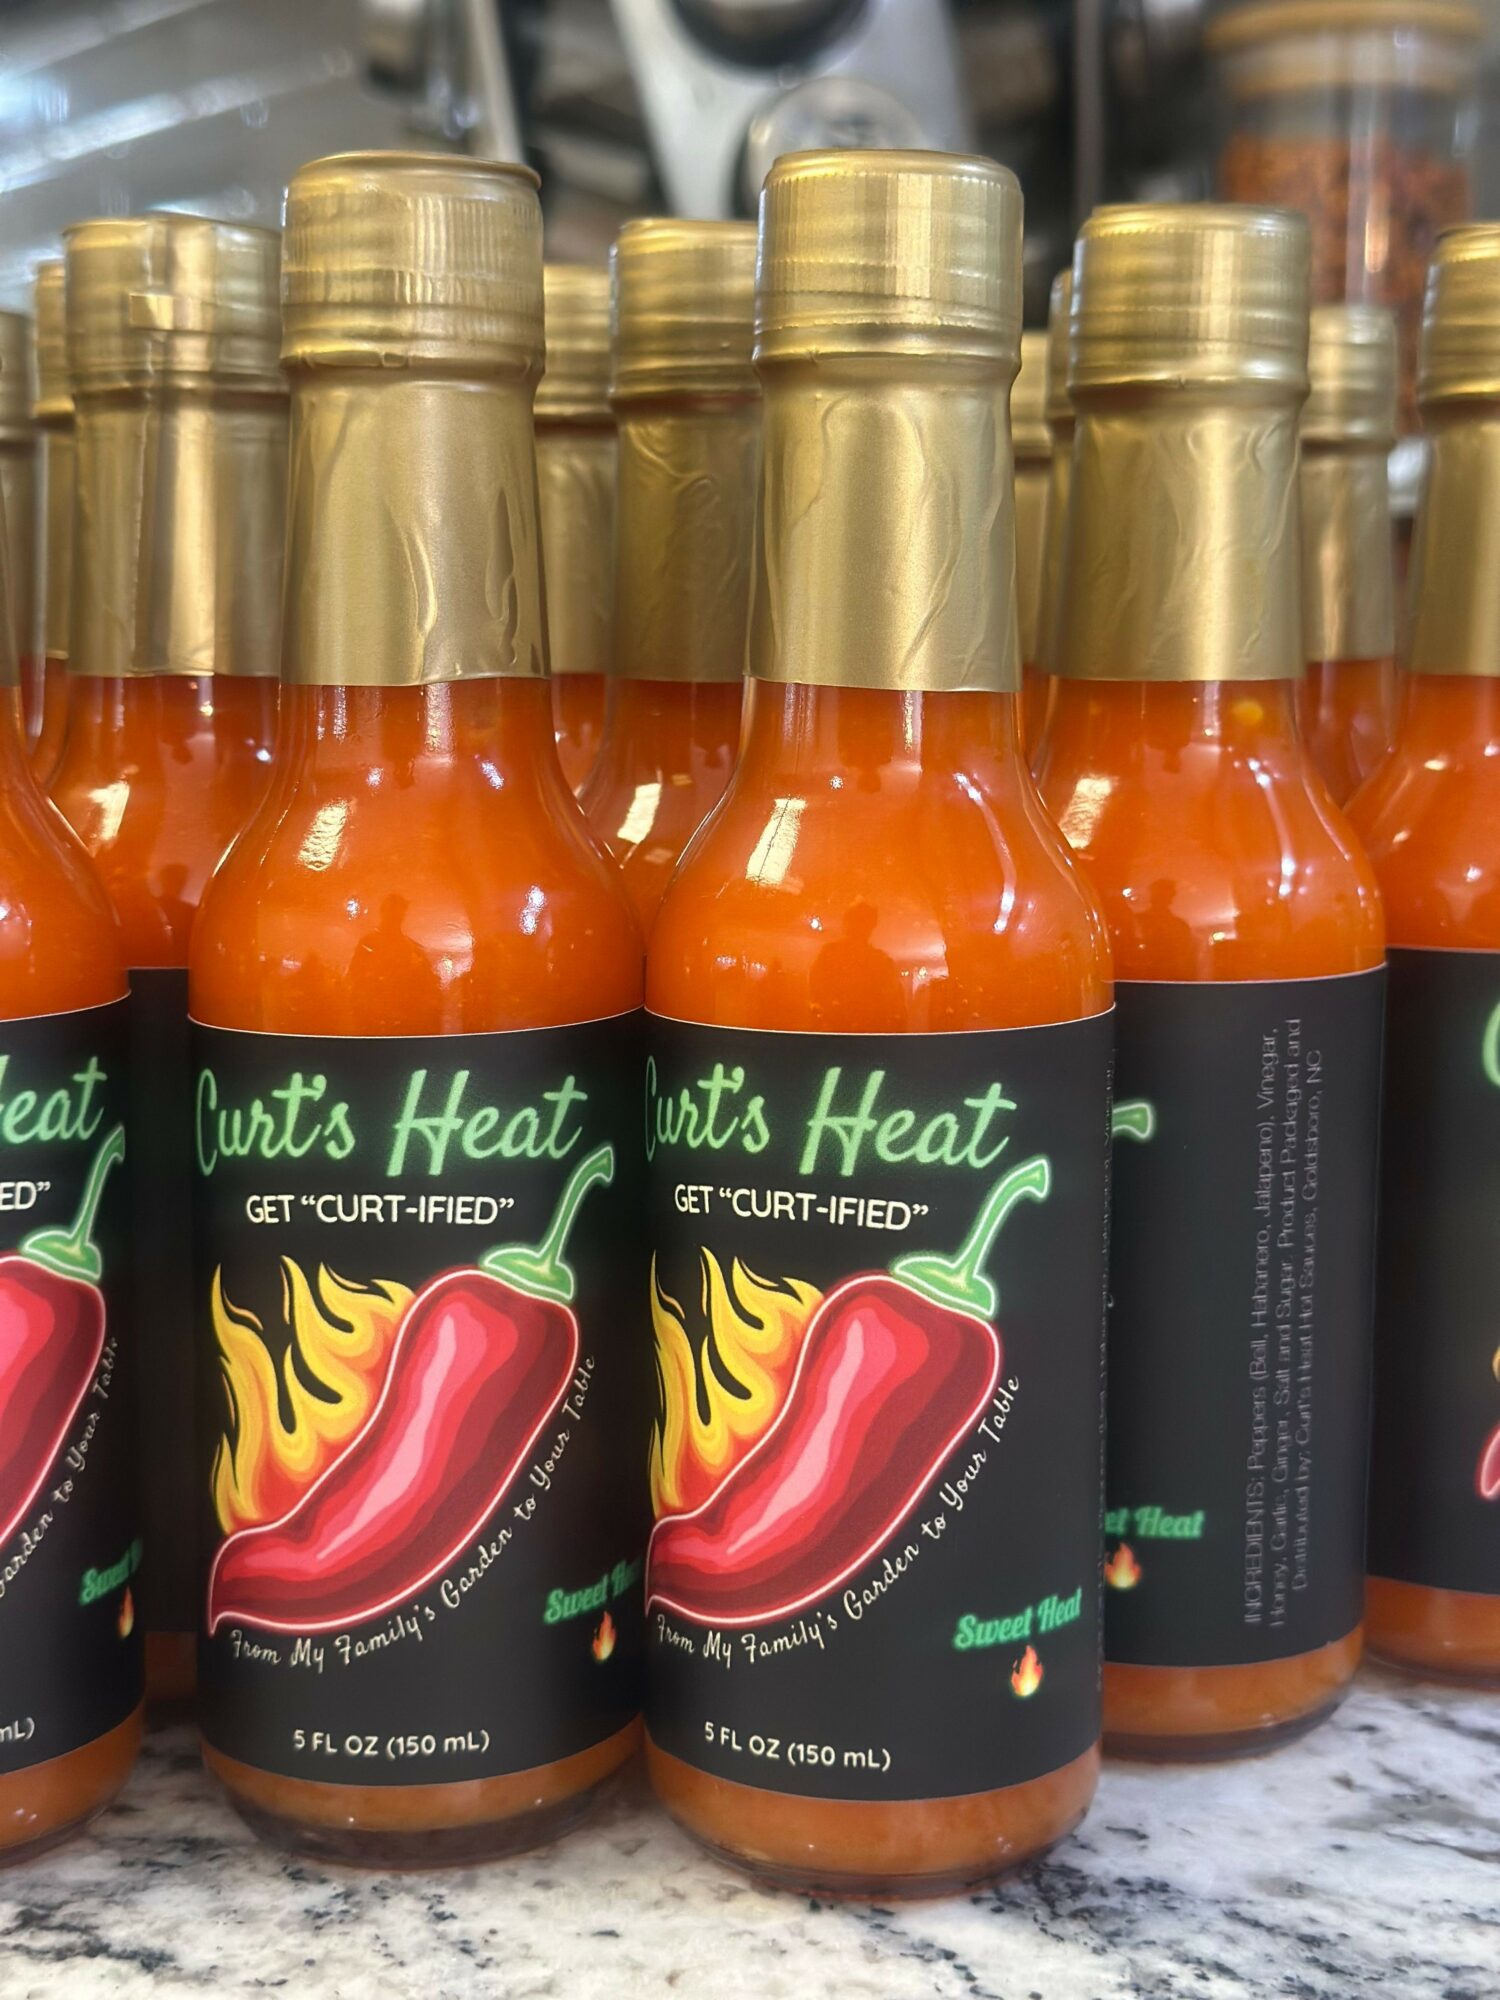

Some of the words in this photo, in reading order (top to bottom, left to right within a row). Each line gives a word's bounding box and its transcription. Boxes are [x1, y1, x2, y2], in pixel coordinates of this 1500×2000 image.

[1284, 1019, 1302, 1057] and
[1305, 1049, 1323, 1084] NC
[0, 1054, 108, 1144] eat
[197, 1068, 355, 1176] Curt's
[386, 1069, 588, 1176] Heat
[645, 1055, 770, 1163] Curt's
[799, 1067, 1017, 1176] Heat
[1280, 1064, 1302, 1163] Packaged
[246, 1195, 295, 1223] GET
[675, 1184, 714, 1214] GET
[1277, 1170, 1296, 1248] Product
[1246, 1386, 1271, 1470] Peppers
[0, 1510, 53, 1599] arden
[53, 1477, 74, 1502] to
[66, 1412, 100, 1472] Your
[230, 1629, 281, 1666] From
[290, 1637, 324, 1674] My
[334, 1604, 436, 1666] Family's
[440, 1526, 513, 1609] Garden
[512, 1493, 537, 1521] to
[529, 1429, 570, 1490] Your
[561, 1355, 595, 1420] Table
[657, 1613, 695, 1654] From
[703, 1630, 732, 1670] My
[741, 1611, 838, 1664] Family's
[843, 1543, 920, 1621] Garden
[921, 1512, 947, 1540] to
[939, 1449, 987, 1512] Your
[977, 1375, 1020, 1444] Table
[1134, 1505, 1205, 1538] Heat
[1244, 1476, 1265, 1623] INGREDIENTS:
[953, 1606, 1033, 1650] Sweet
[1037, 1585, 1083, 1634] Heat
[293, 1729, 306, 1749] 5
[312, 1732, 338, 1754] FL
[345, 1735, 379, 1756] OZ
[386, 1735, 436, 1760] (150
[444, 1729, 490, 1753] mL)
[704, 1721, 715, 1742] 5
[720, 1726, 742, 1751] FL
[749, 1735, 781, 1760] OZ
[787, 1742, 836, 1767] (150
[843, 1748, 891, 1772] mL)
